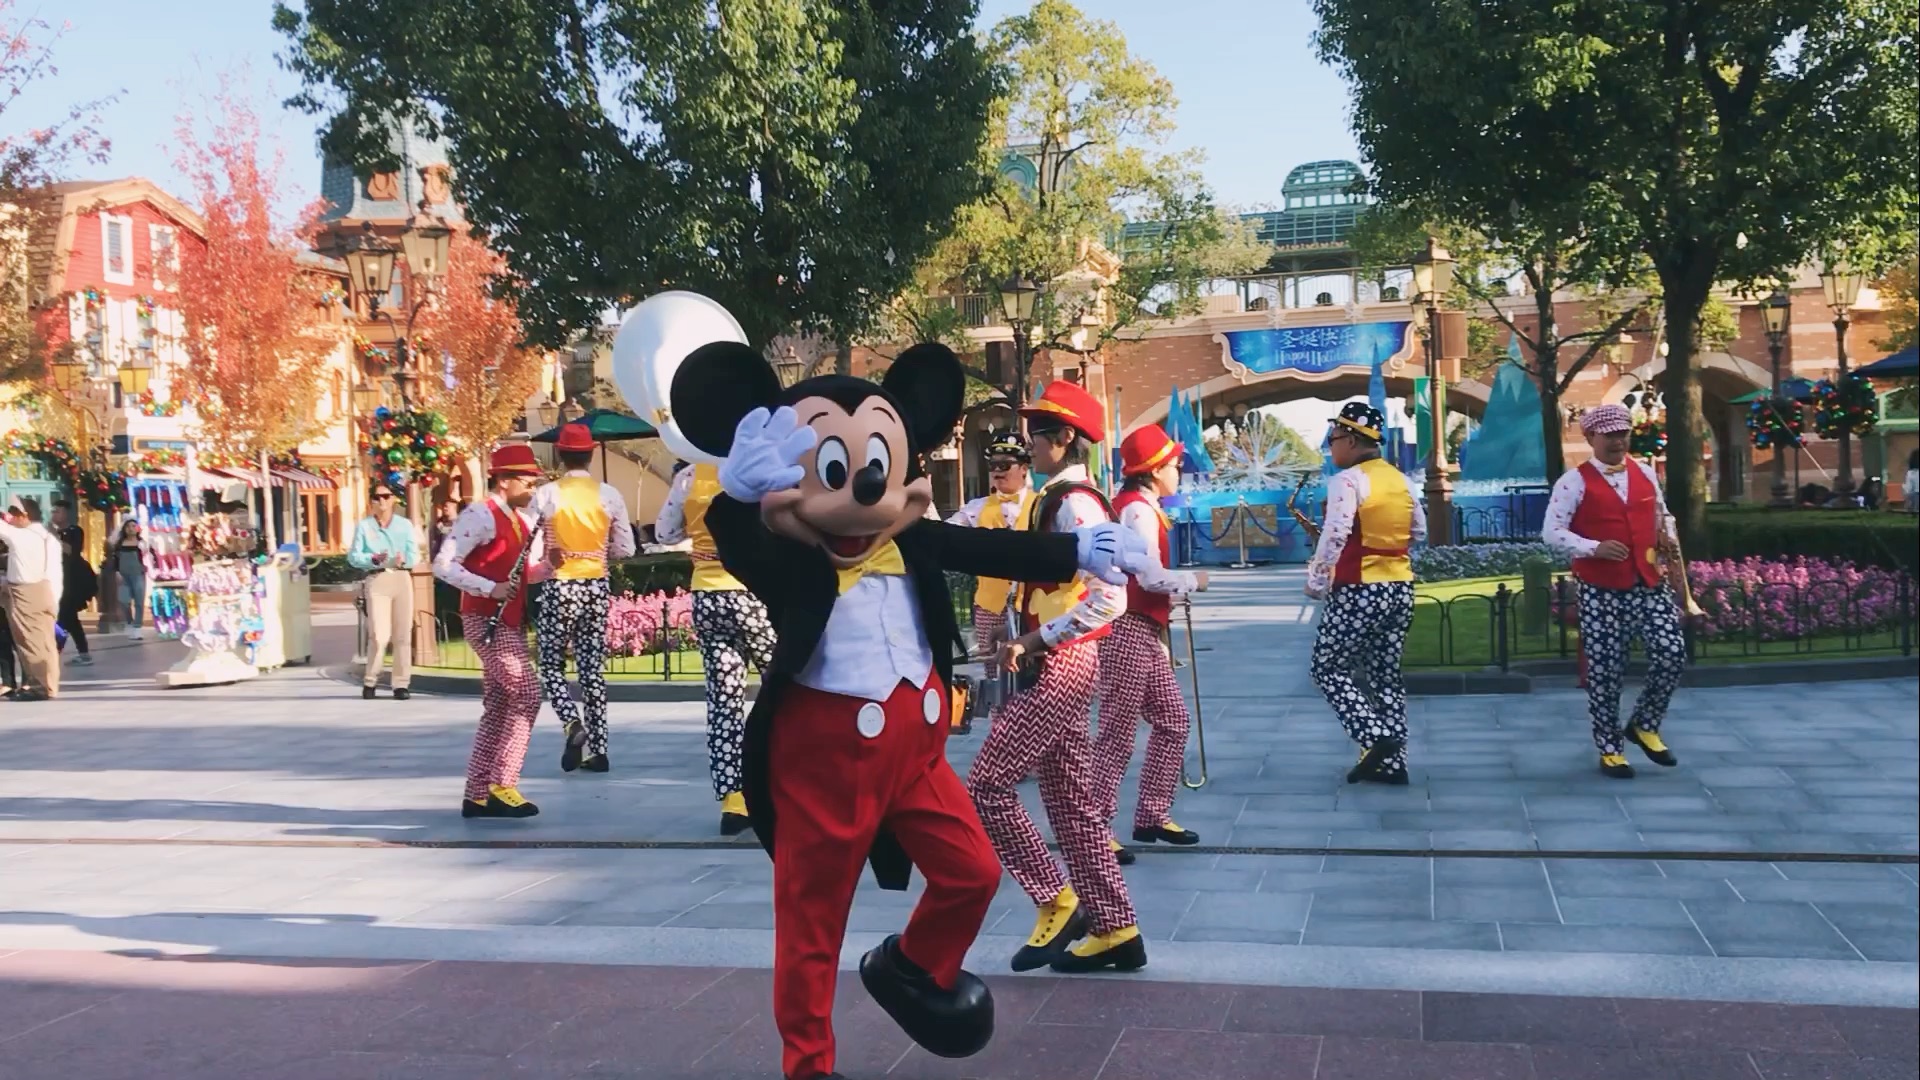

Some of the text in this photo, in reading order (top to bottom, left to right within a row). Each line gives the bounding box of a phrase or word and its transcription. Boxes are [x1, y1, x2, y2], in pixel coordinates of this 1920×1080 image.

[1280, 327, 1355, 349] 圣诞快乐
[1275, 350, 1310, 366] Happy
